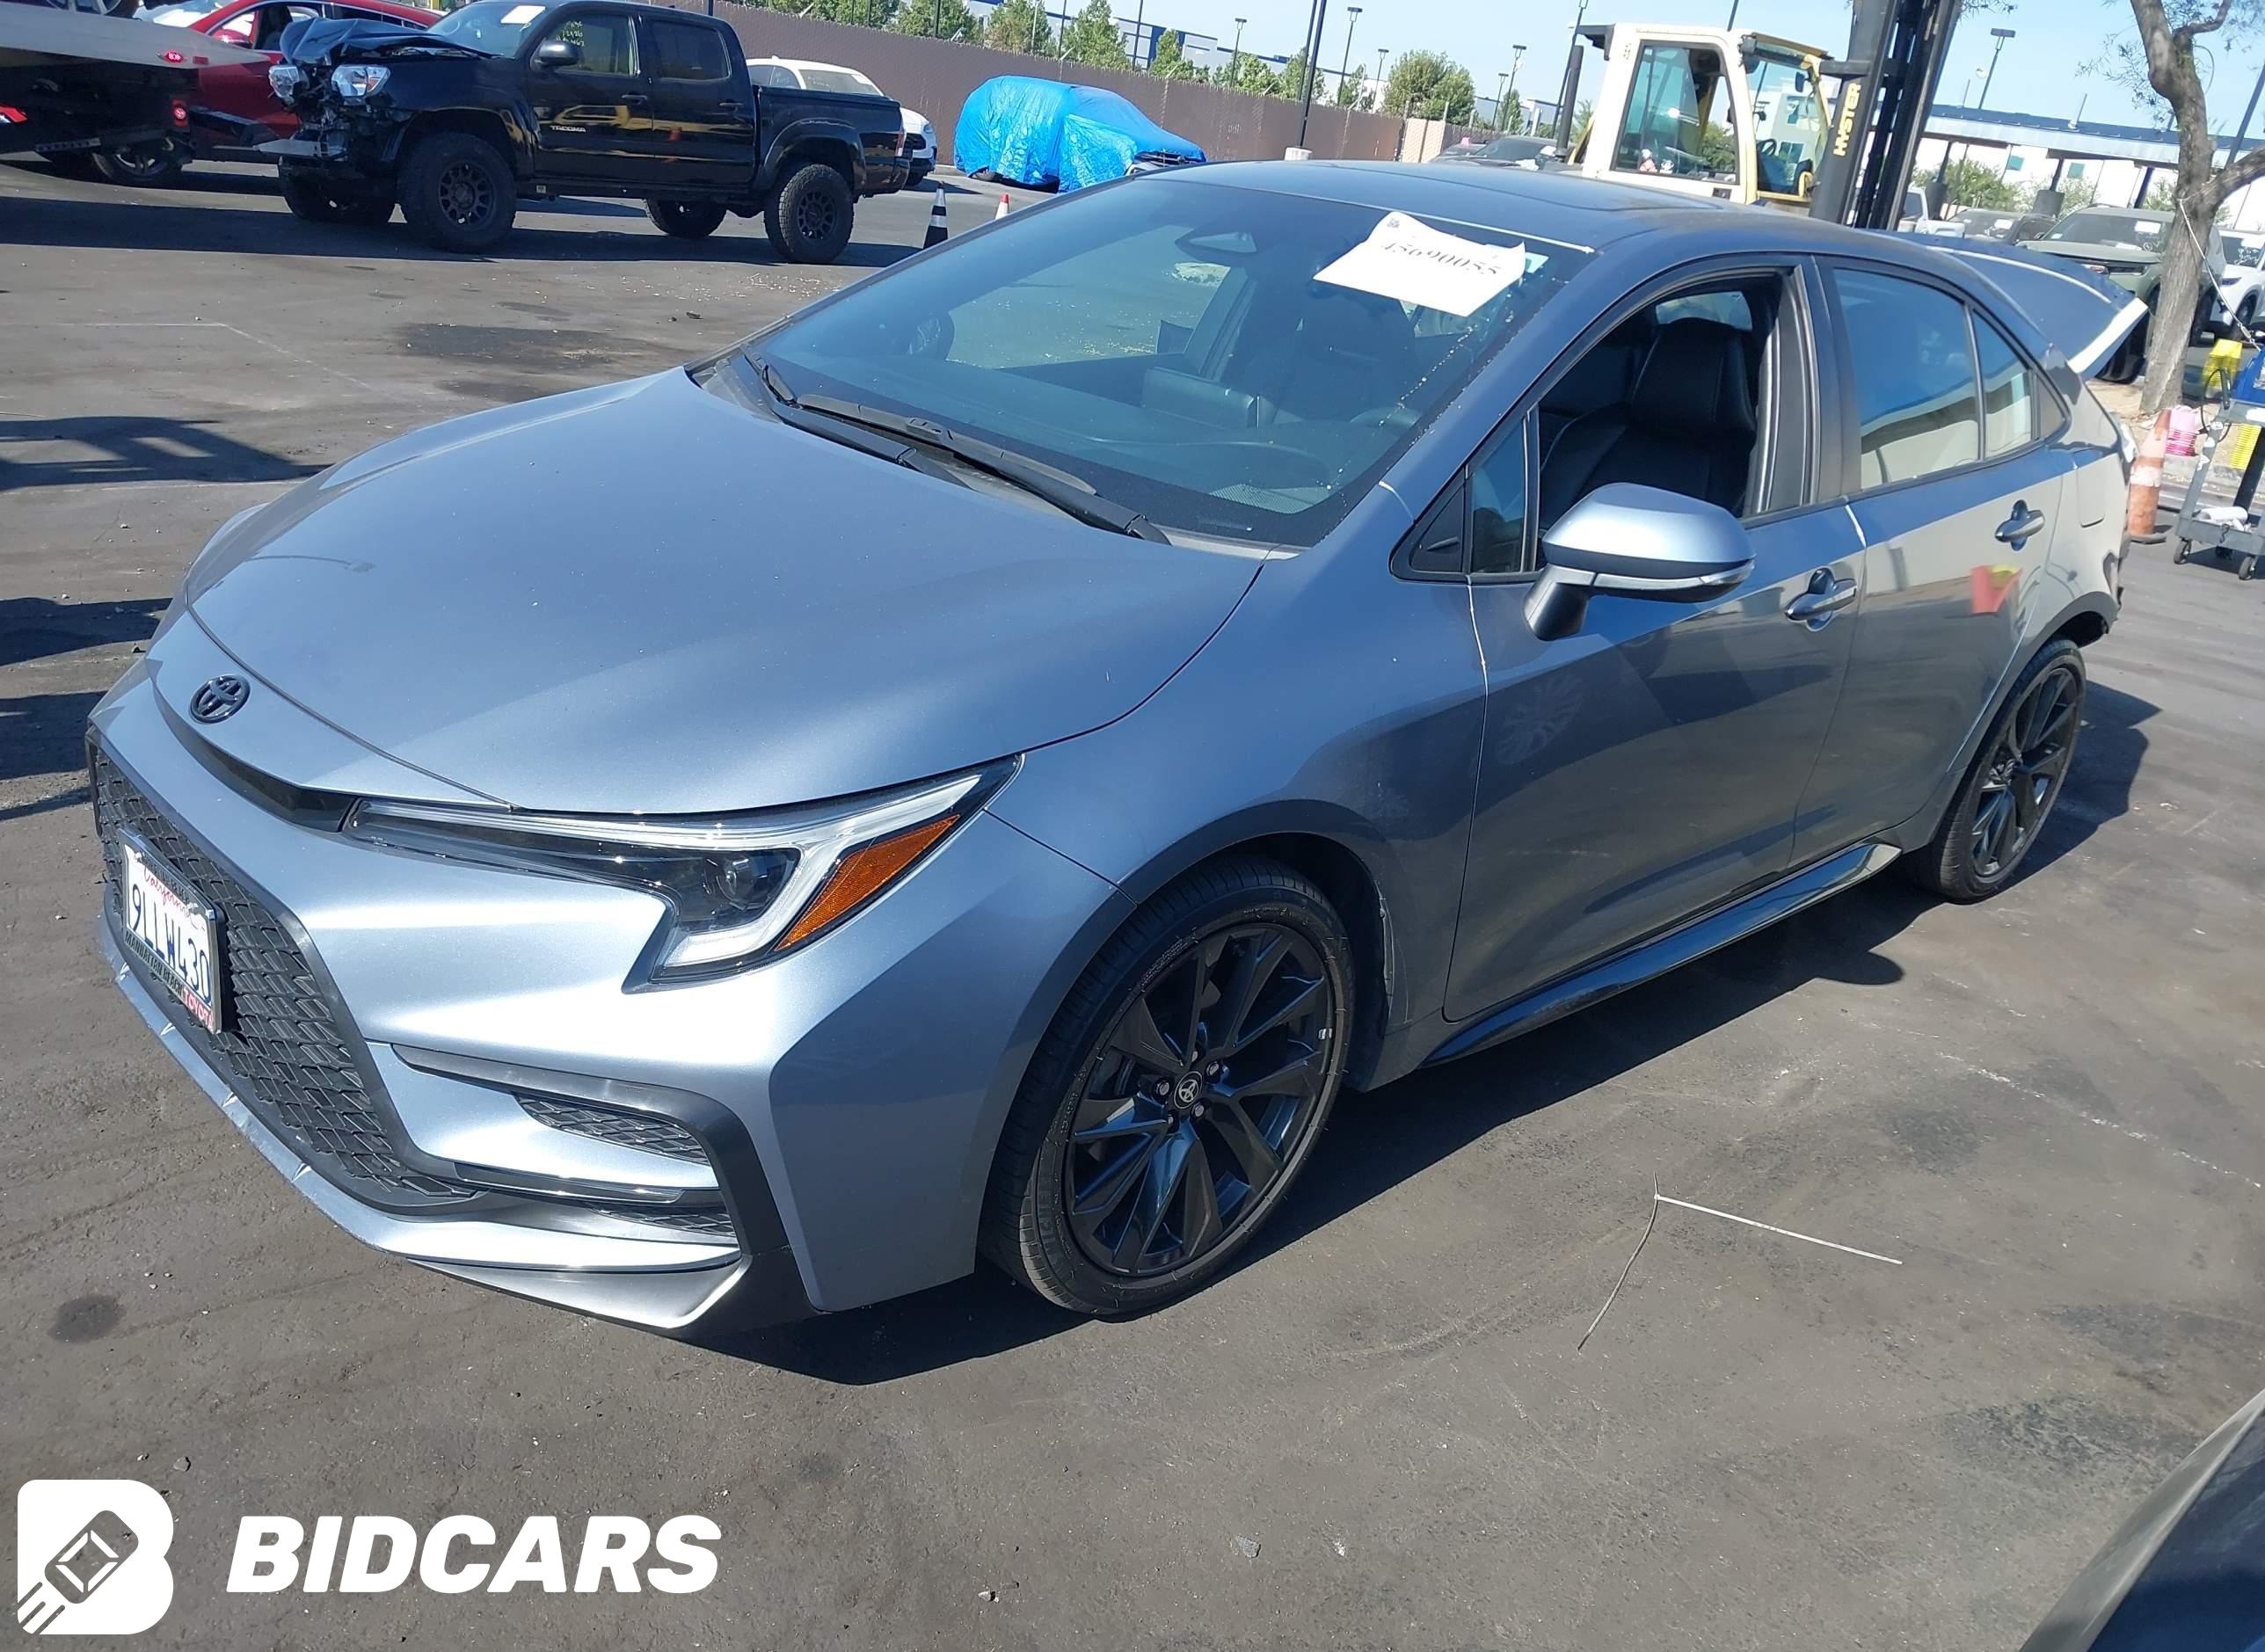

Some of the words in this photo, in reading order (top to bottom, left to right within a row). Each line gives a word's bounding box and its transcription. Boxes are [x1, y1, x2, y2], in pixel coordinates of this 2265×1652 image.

[1832, 83, 1861, 156] HYSTER
[125, 930, 162, 977] MANHATTAN
[164, 969, 184, 997] BEACH
[183, 986, 214, 1030] TOYOTA
[132, 883, 212, 1003] 9LLW430
